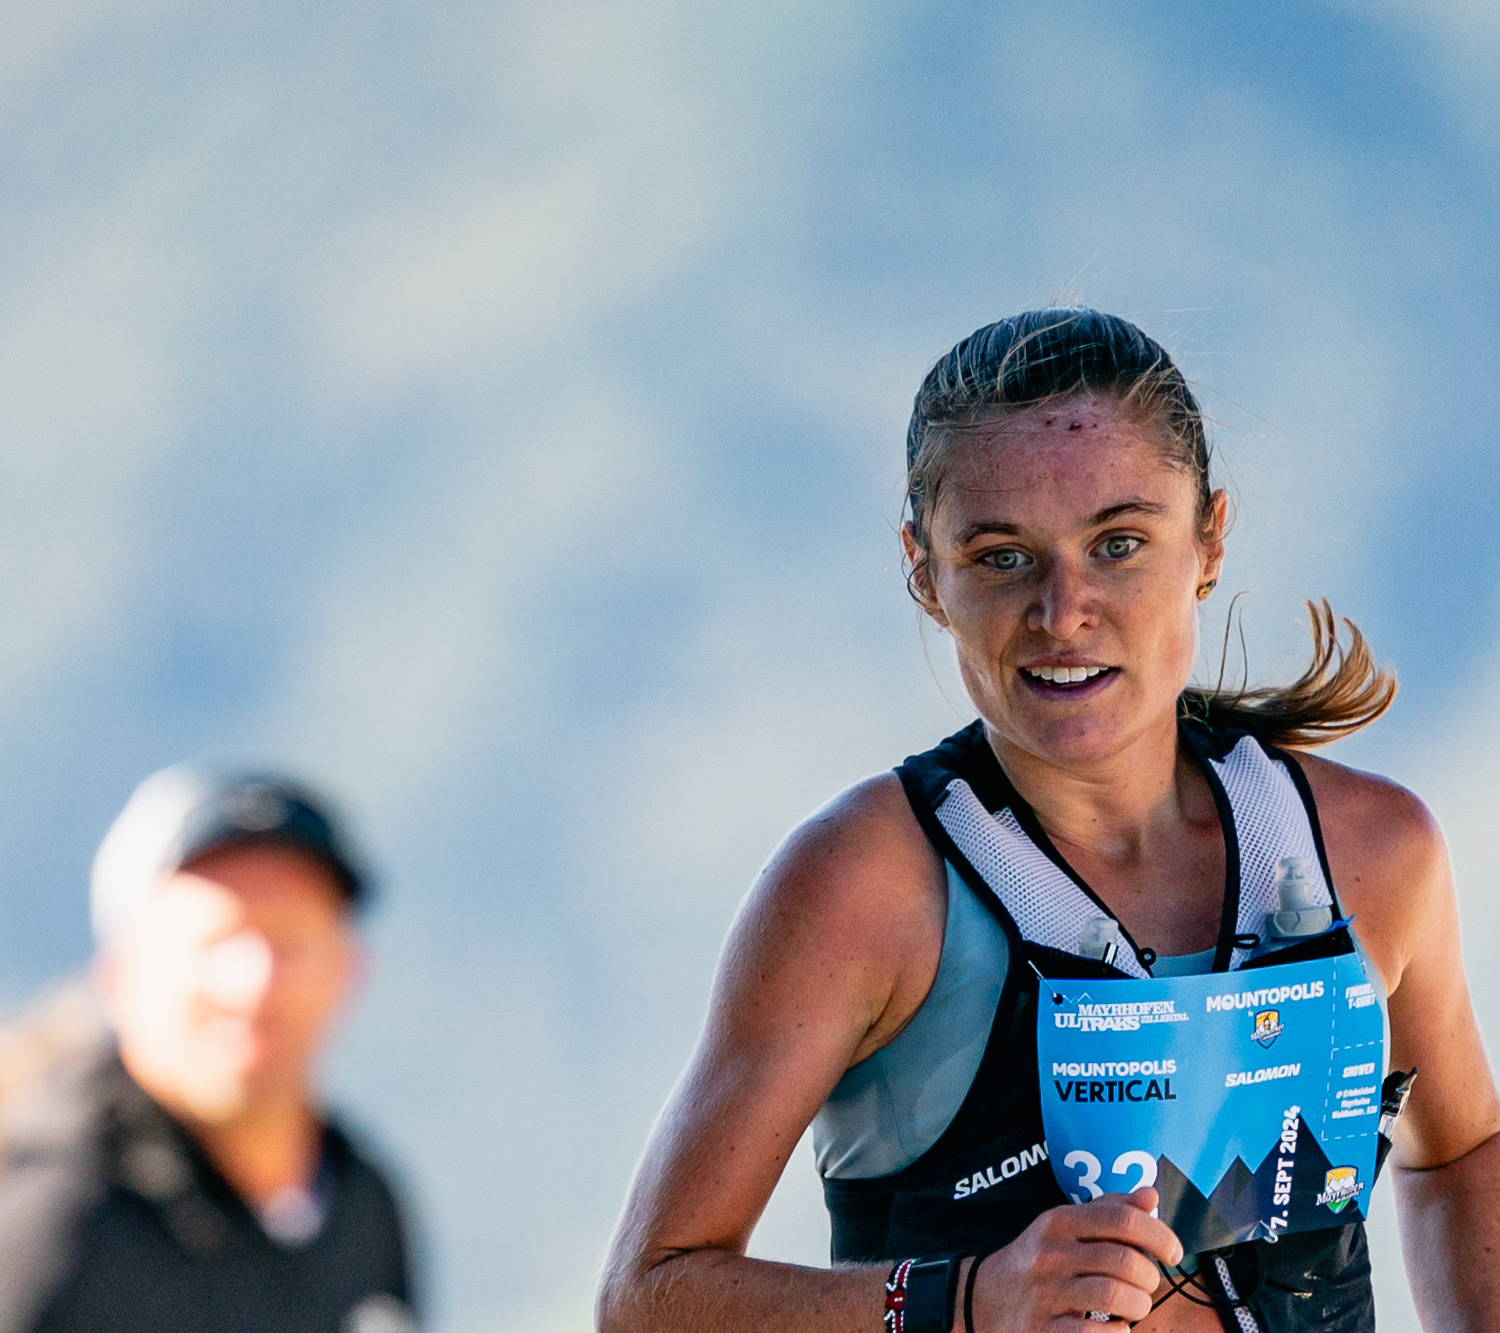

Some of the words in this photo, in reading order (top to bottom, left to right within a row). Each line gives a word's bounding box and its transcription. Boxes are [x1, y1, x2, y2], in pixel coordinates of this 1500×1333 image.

[1206, 981, 1325, 1012] MOUNTOPOLIS
[1078, 1001, 1175, 1017] MAYRHOFEN
[1140, 1013, 1190, 1024] ZILLERTAL
[1052, 1059, 1177, 1077] MOUNTOPOLIS
[1225, 1063, 1301, 1087] SALOMON
[1054, 1078, 1177, 1102] VERTICAL
[1280, 1105, 1301, 1153] 2024
[953, 1140, 1049, 1200] SALOM
[1273, 1157, 1295, 1205] SEPT
